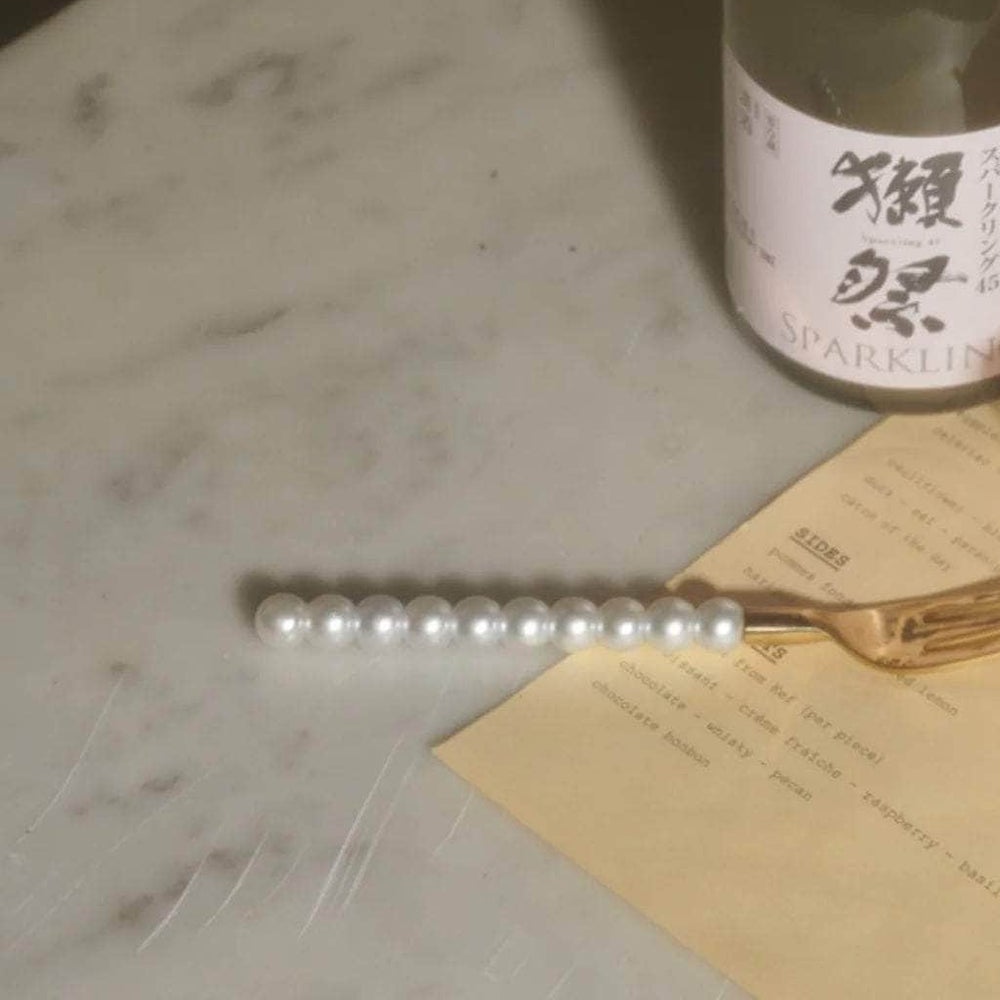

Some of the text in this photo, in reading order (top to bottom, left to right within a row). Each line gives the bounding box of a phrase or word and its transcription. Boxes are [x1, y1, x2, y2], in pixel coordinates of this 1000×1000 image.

[793, 526, 851, 570] SIDES
[591, 679, 660, 731] chocolate
[619, 660, 688, 711] chocolate
[768, 769, 813, 801] pecan
[862, 790, 941, 850] raspberry
